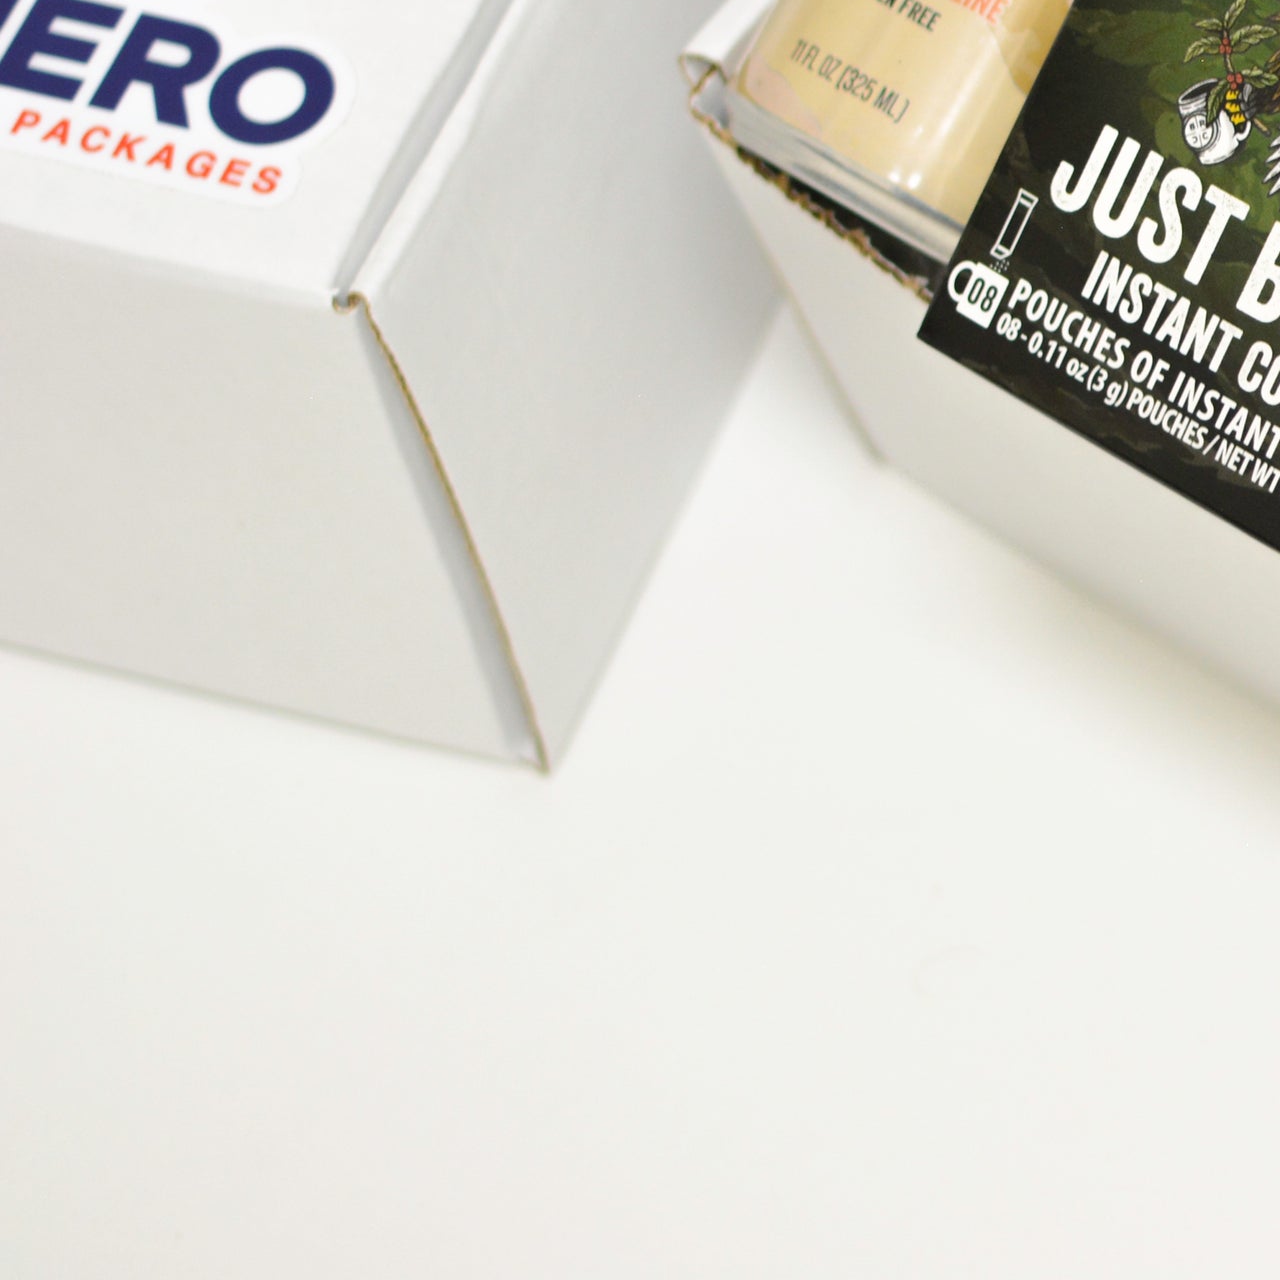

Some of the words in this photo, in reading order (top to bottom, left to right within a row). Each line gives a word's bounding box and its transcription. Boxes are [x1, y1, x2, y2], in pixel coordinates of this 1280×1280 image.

[10, 108, 283, 195] PACKAGES
[1049, 123, 1250, 287] JUST
[966, 277, 999, 313] 08
[1006, 277, 1131, 370] POUCHES
[1129, 349, 1171, 391] OF
[1080, 251, 1244, 374] INSTANT
[1064, 357, 1090, 384] oz
[1125, 387, 1210, 451] POUCHES
[1214, 439, 1256, 477] NET
